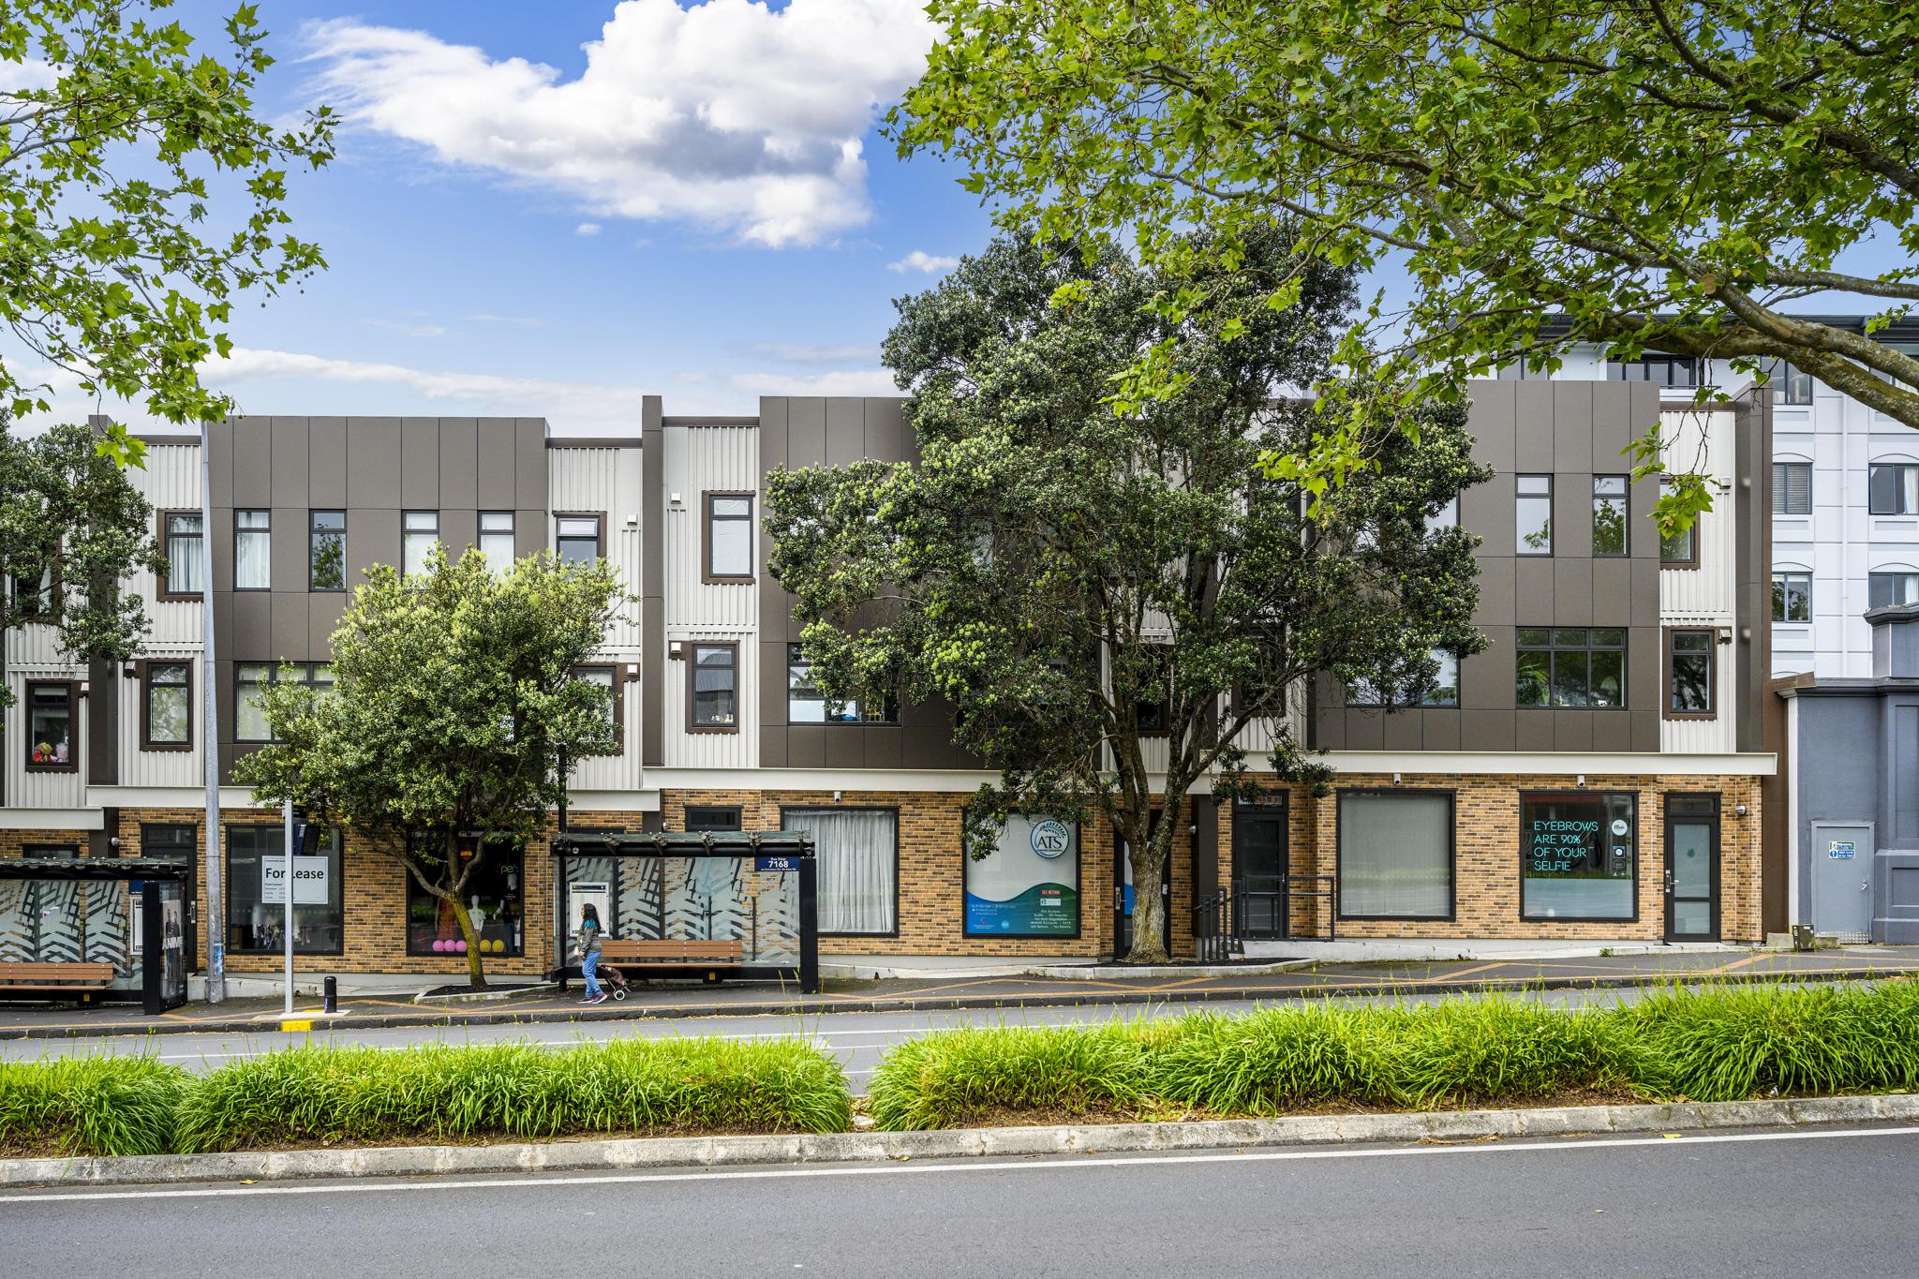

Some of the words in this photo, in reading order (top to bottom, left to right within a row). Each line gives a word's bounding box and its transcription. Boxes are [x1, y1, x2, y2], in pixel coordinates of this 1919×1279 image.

[1534, 820, 1599, 831] EYEBROWS
[1036, 836, 1062, 849] ATS
[1534, 834, 1557, 844] ARE
[1560, 834, 1581, 844] 90%
[1533, 847, 1550, 857] OF
[1554, 847, 1587, 857] YOUR
[768, 860, 789, 868] 7168
[1534, 860, 1571, 871] SELFIE
[265, 867, 286, 878] For
